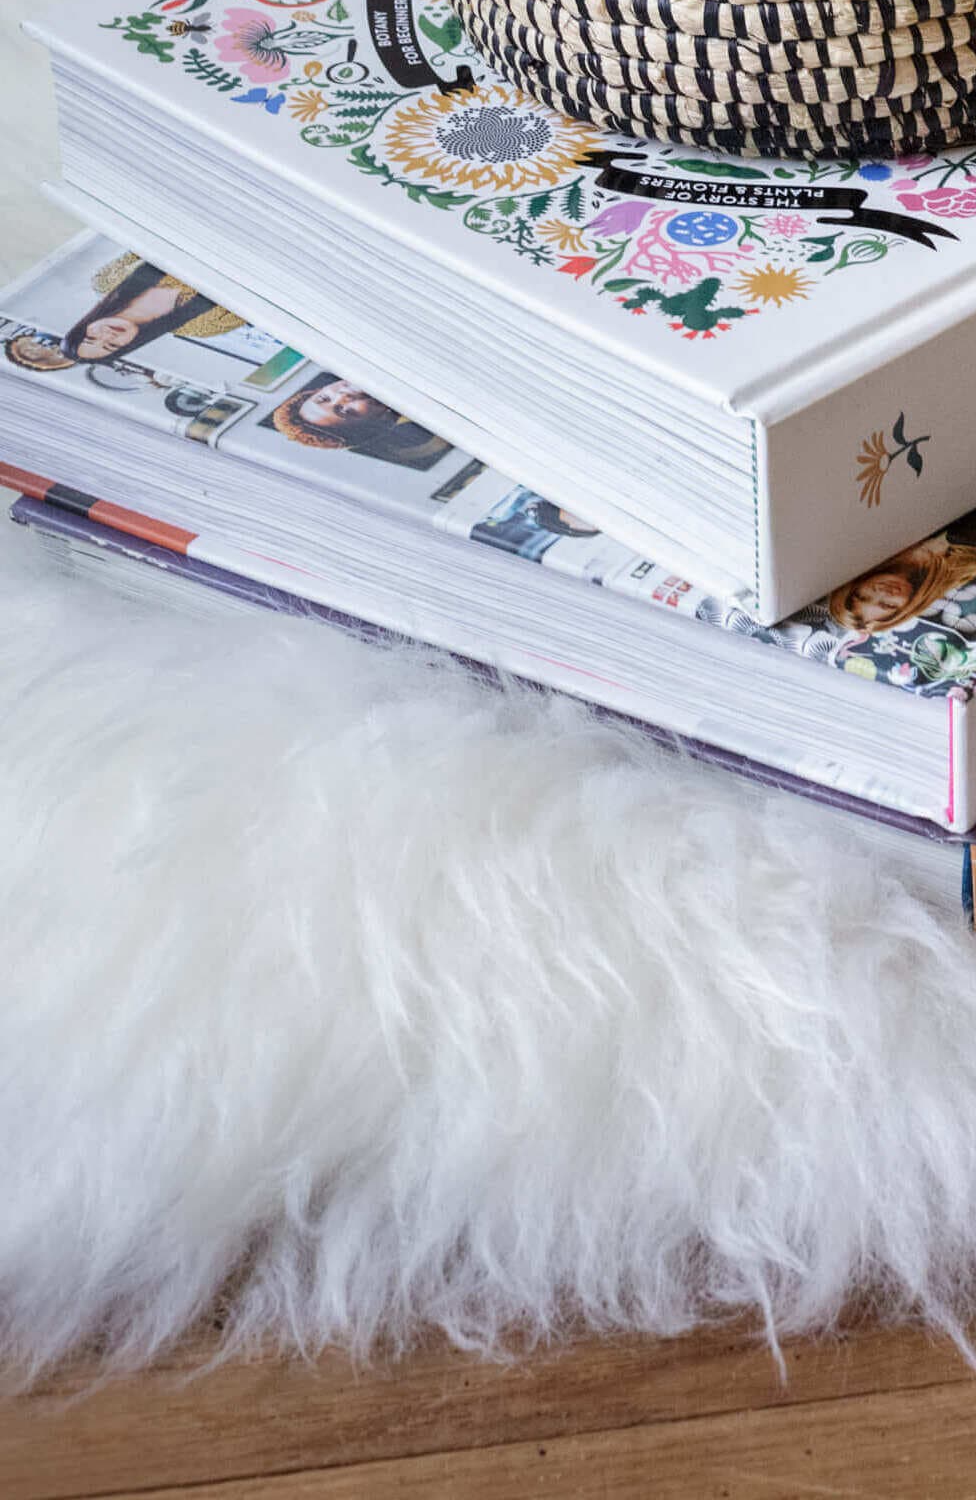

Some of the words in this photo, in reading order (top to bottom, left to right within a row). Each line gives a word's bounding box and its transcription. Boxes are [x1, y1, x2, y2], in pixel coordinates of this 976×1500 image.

[373, 10, 392, 47] BOTANY
[401, 45, 423, 65] FOR
[639, 176, 729, 194] FLOWERS
[735, 185, 749, 194] &
[664, 191, 692, 201] OF
[753, 186, 825, 198] PLANTS
[696, 193, 758, 206] STORY
[763, 196, 801, 208] THE
